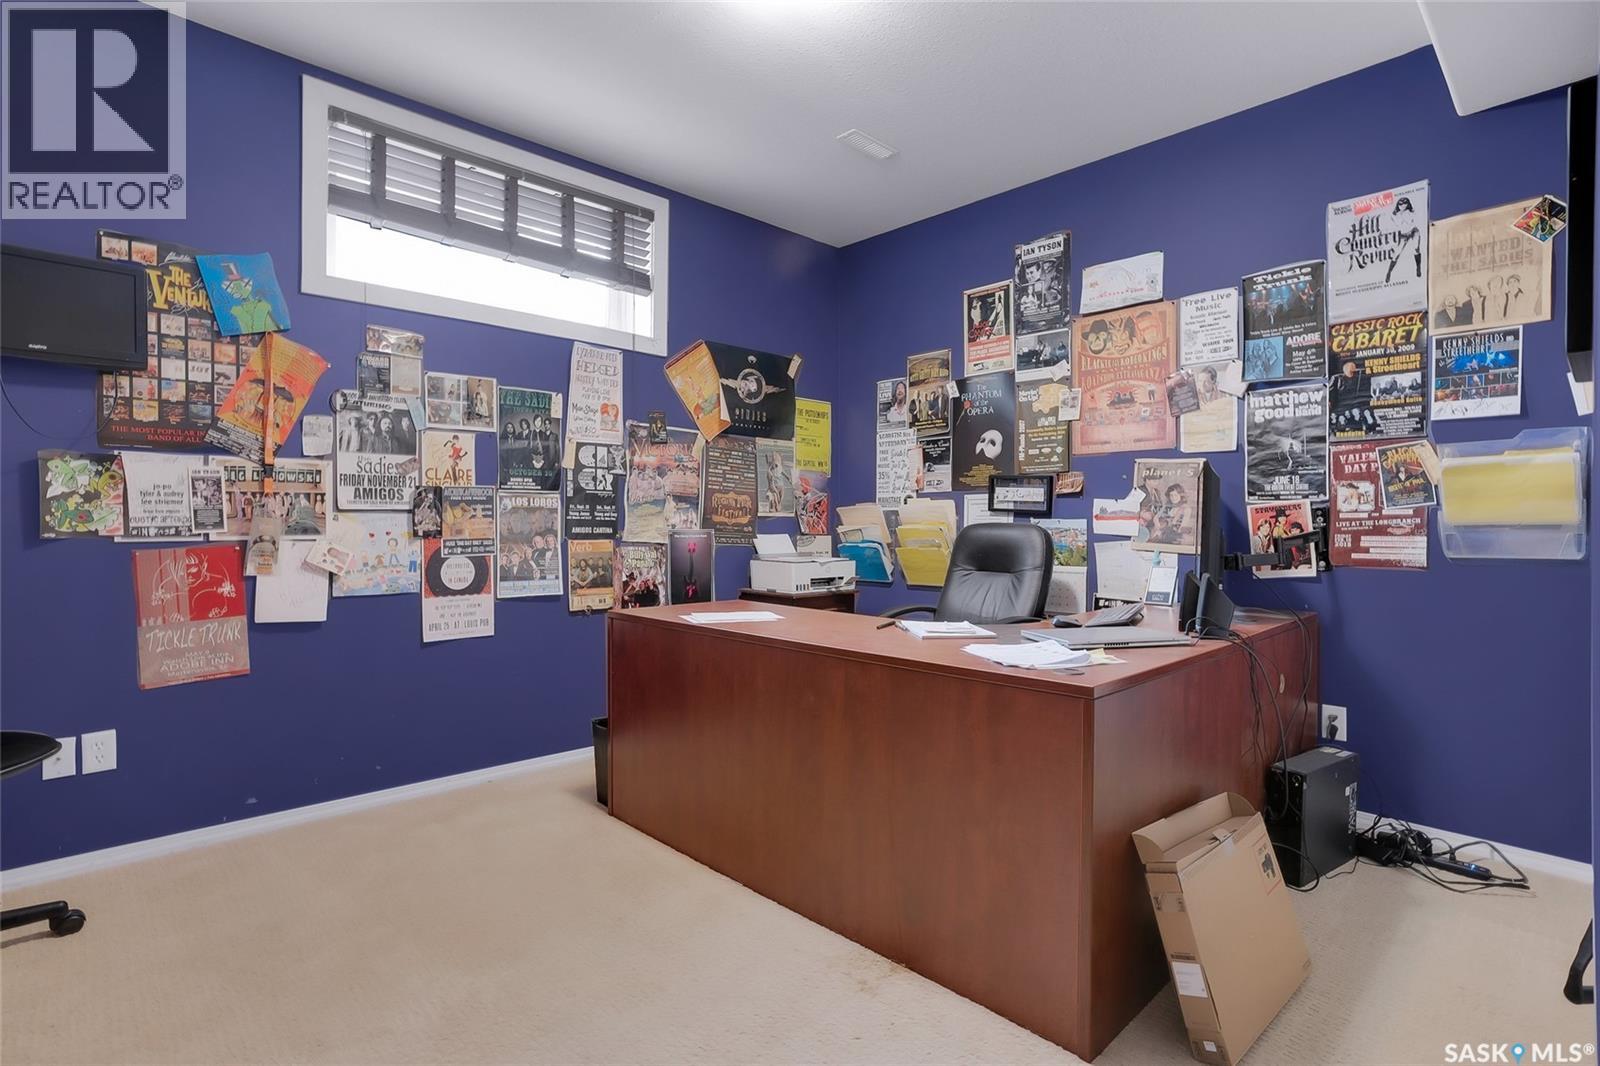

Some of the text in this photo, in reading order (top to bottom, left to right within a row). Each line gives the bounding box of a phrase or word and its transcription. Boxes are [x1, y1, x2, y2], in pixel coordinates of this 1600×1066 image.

[1349, 214, 1381, 238] Hill
[1023, 240, 1062, 257] IAN TYSON
[1335, 230, 1401, 255] Country
[1450, 237, 1521, 260] WANTED
[1348, 246, 1396, 273] Revue
[1441, 248, 1533, 272] THE SADIES
[169, 264, 192, 287] THE
[1253, 275, 1312, 290] Trunk
[1182, 293, 1232, 307] Free Live
[1195, 303, 1222, 312] Music
[1331, 311, 1424, 336] CLASSIC ROCK
[1286, 332, 1321, 346] ADOBE
[1332, 324, 1424, 352] CABARET
[1442, 336, 1468, 349] KENNY
[1470, 333, 1504, 347] SHIELDS
[1292, 350, 1306, 358] May
[1355, 348, 1385, 357] JANUARY
[1398, 343, 1415, 353] 2009
[1442, 343, 1491, 358] STREETHEART
[961, 390, 1002, 401] PHANTOM
[1249, 391, 1324, 408] matthew
[967, 405, 994, 416] OPERA
[1254, 405, 1294, 424] good
[157, 429, 197, 437] POPULAR
[1142, 467, 1194, 478] planet S
[1345, 463, 1368, 474] DAY
[252, 469, 321, 483] LOWSKI
[340, 474, 417, 488] FRIDAY NOVEMBER 21
[353, 488, 404, 501] AMIGOS
[511, 497, 558, 508] LOS LOBOS
[1255, 504, 1302, 514] STAMDERS
[1375, 517, 1421, 525] LONGBRANCH
[570, 542, 593, 551] Verb
[145, 621, 242, 653] TICKLE TRUNK
[160, 656, 206, 673] ADOBE
[211, 654, 235, 665] INN
